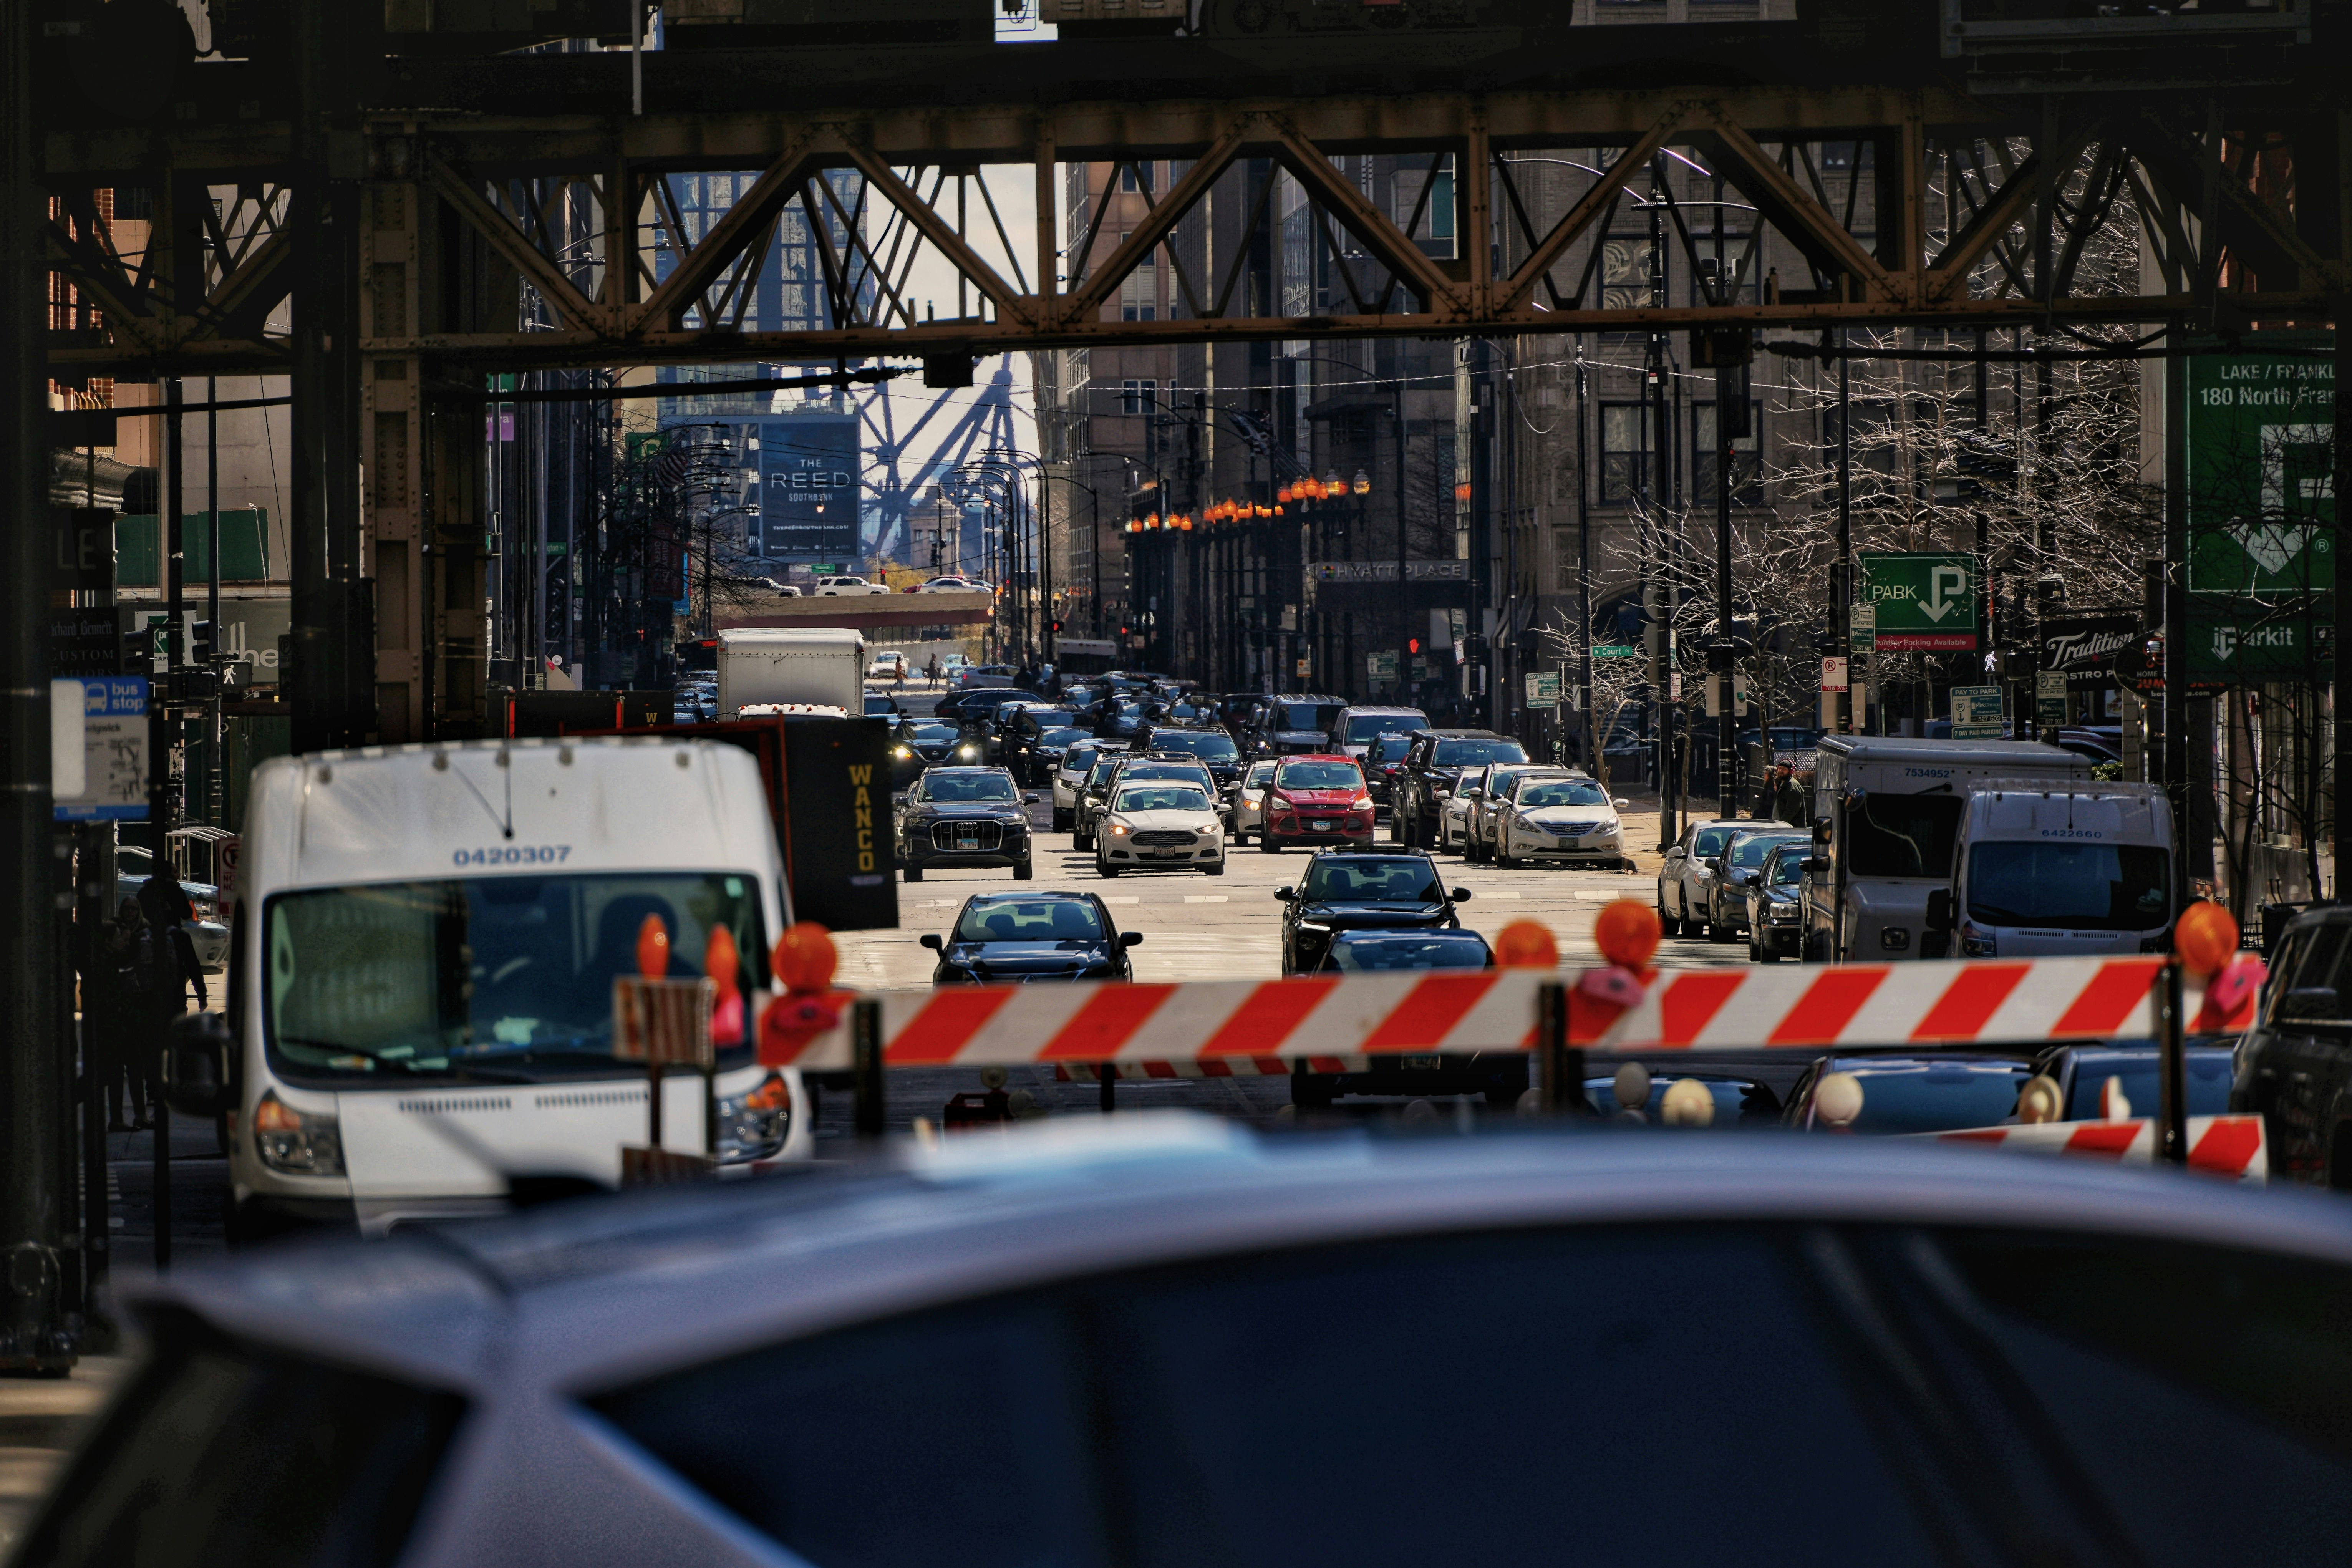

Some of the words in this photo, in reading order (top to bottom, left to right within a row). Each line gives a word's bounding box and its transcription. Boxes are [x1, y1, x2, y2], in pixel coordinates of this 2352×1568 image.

[2221, 365, 2260, 380] LAKE
[2200, 387, 2233, 406] 180
[2239, 386, 2291, 405] North
[800, 459, 822, 467] THE
[771, 472, 850, 488] REED
[1338, 565, 1394, 577] HYATT
[1405, 565, 1461, 577] PLACE
[1872, 585, 1918, 599] PARK
[1904, 639, 1931, 647] Parking
[2046, 630, 2134, 670] Tradition
[112, 682, 138, 696] bus
[112, 697, 144, 711] stop
[1905, 768, 1950, 778] 7534952
[848, 764, 875, 872] WANCO
[2042, 830, 2102, 839] 6422660
[454, 845, 572, 867] 0420307
